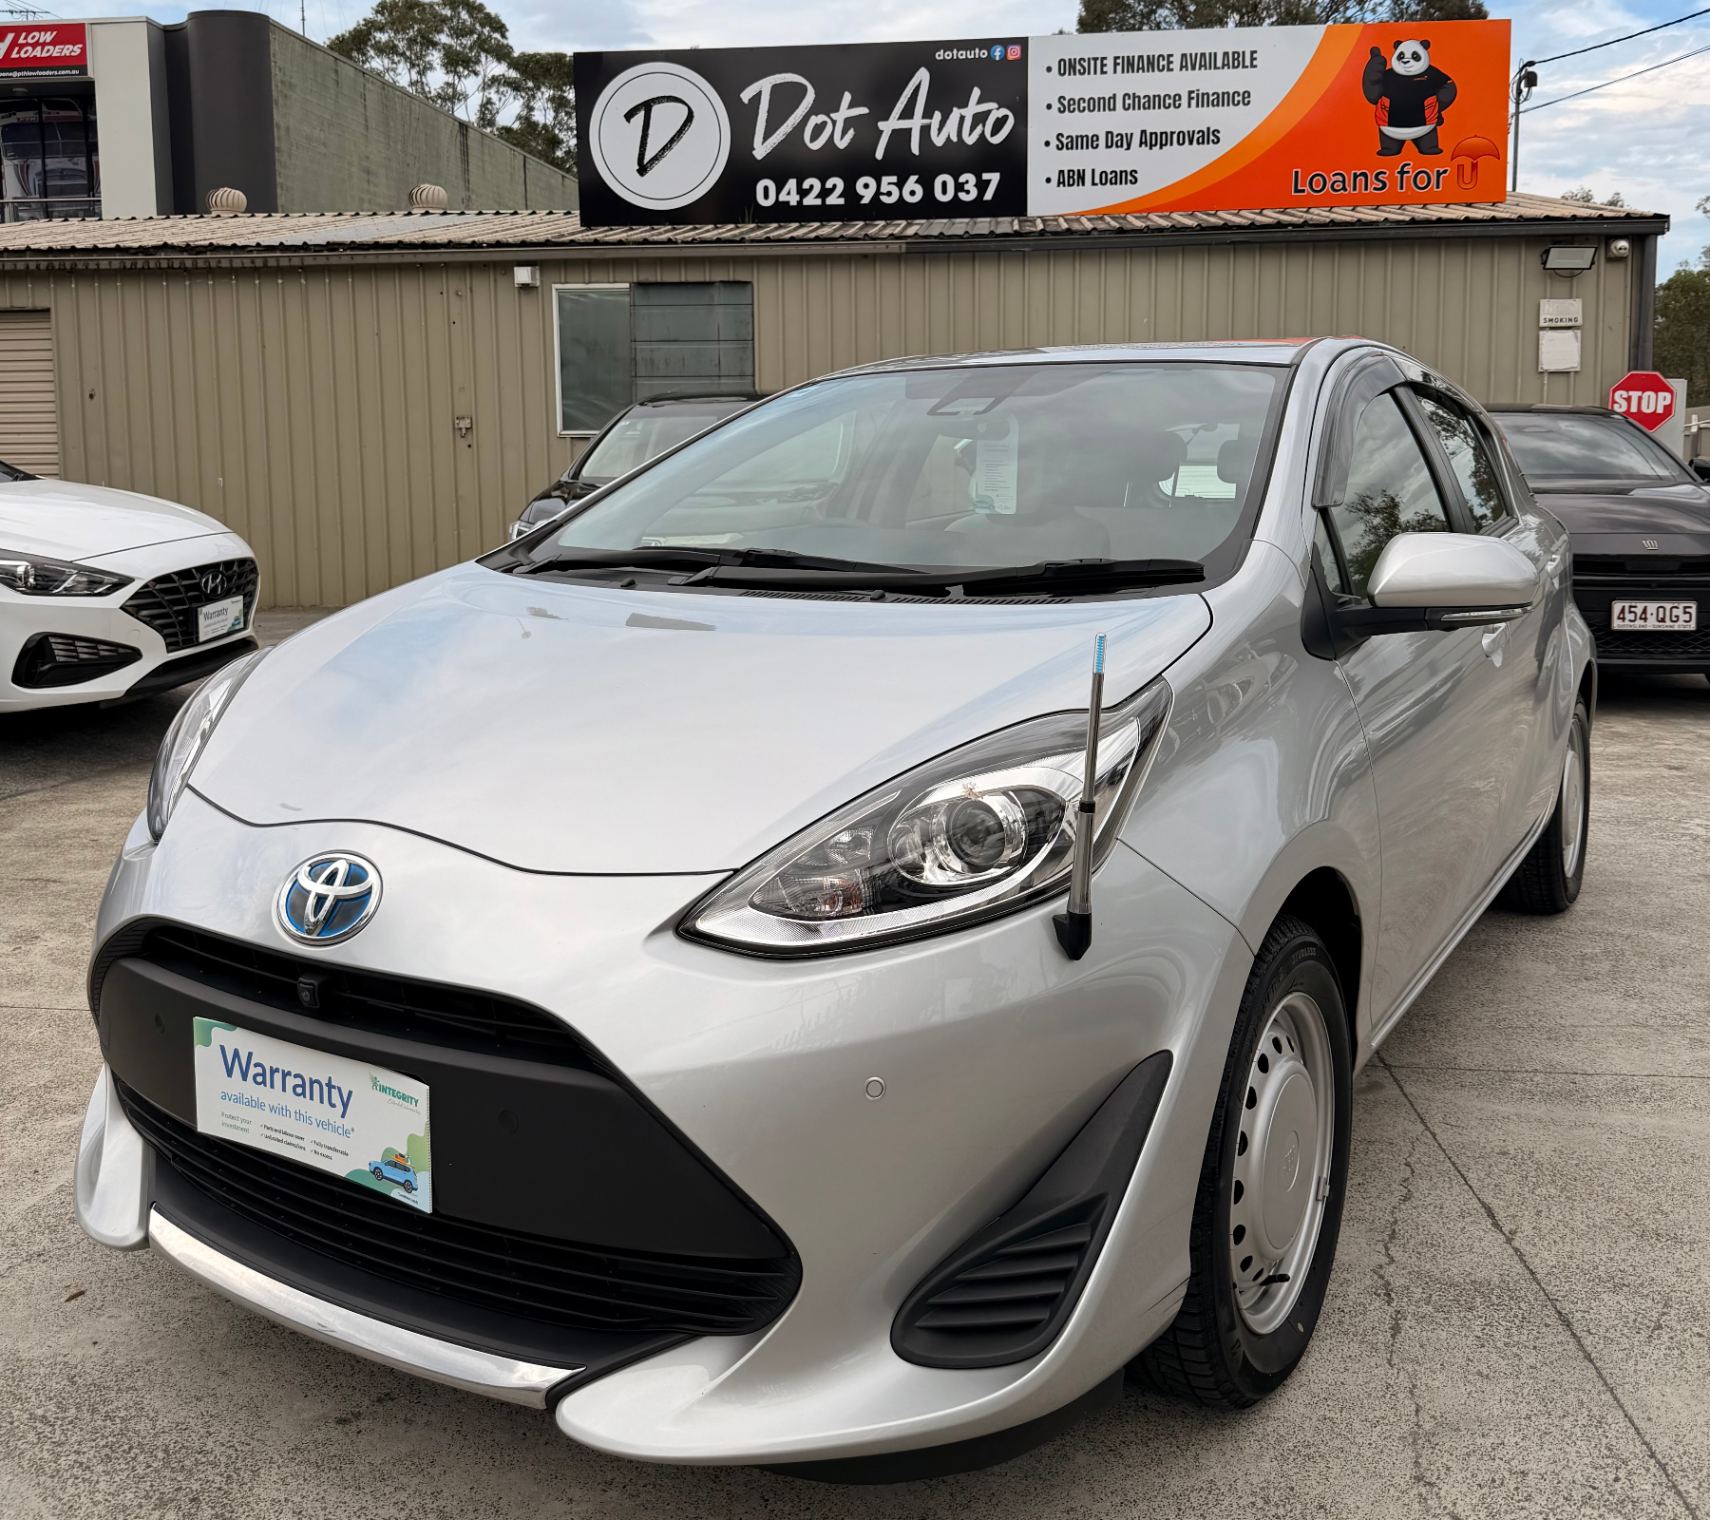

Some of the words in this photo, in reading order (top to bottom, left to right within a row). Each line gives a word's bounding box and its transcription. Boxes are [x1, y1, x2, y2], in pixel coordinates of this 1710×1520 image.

[10, 44, 83, 58] LOADERS
[18, 31, 57, 44] LOW
[935, 47, 989, 61] dotauto
[1057, 56, 1108, 77] ONSITE
[1113, 53, 1175, 75] FINANCE
[1179, 50, 1258, 73] AVAILABLE
[740, 72, 869, 161] Dot
[875, 67, 1015, 161] Auto
[1057, 93, 1117, 115] Second
[1122, 91, 1182, 112] Chance
[1187, 88, 1251, 110] Finance
[623, 95, 695, 178] D
[1055, 131, 1099, 152] Same
[1105, 129, 1134, 153] Day
[1139, 126, 1221, 151] Approvals
[756, 178, 845, 207] 0422
[855, 175, 924, 205] 956
[934, 172, 1001, 202] 037
[1056, 168, 1086, 188] ABN
[1091, 168, 1138, 187] Loans
[1292, 167, 1389, 197] Loans
[1397, 162, 1450, 193] for
[1543, 316, 1579, 324] SMOKING
[1613, 390, 1672, 413] STOP
[203, 607, 229, 621] Warranty
[219, 1044, 353, 1119] Warranty
[220, 1090, 266, 1111] available
[268, 1103, 293, 1118] with
[294, 1109, 314, 1125] this
[378, 1085, 419, 1108] INTEGRITY
